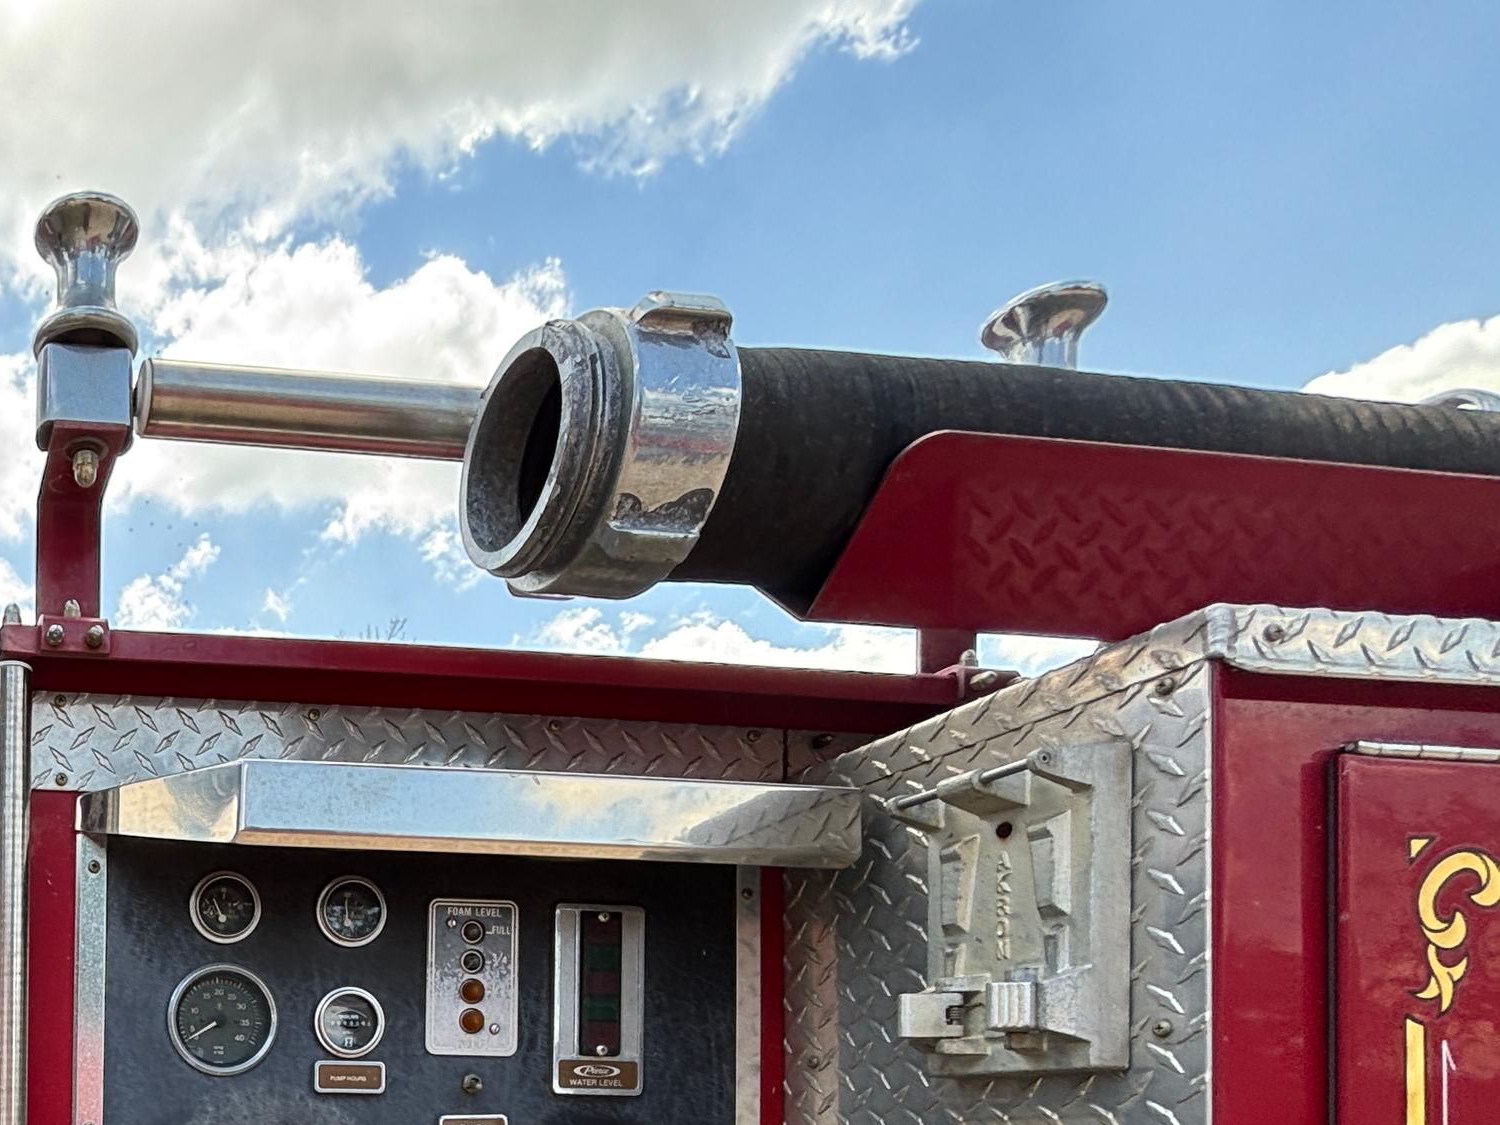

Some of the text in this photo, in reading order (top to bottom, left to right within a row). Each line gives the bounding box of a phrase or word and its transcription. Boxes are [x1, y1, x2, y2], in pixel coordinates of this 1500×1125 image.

[447, 906, 502, 917] FOAM LEVEL
[491, 926, 510, 935] FULL
[569, 1078, 623, 1087] WATER LEVEL
